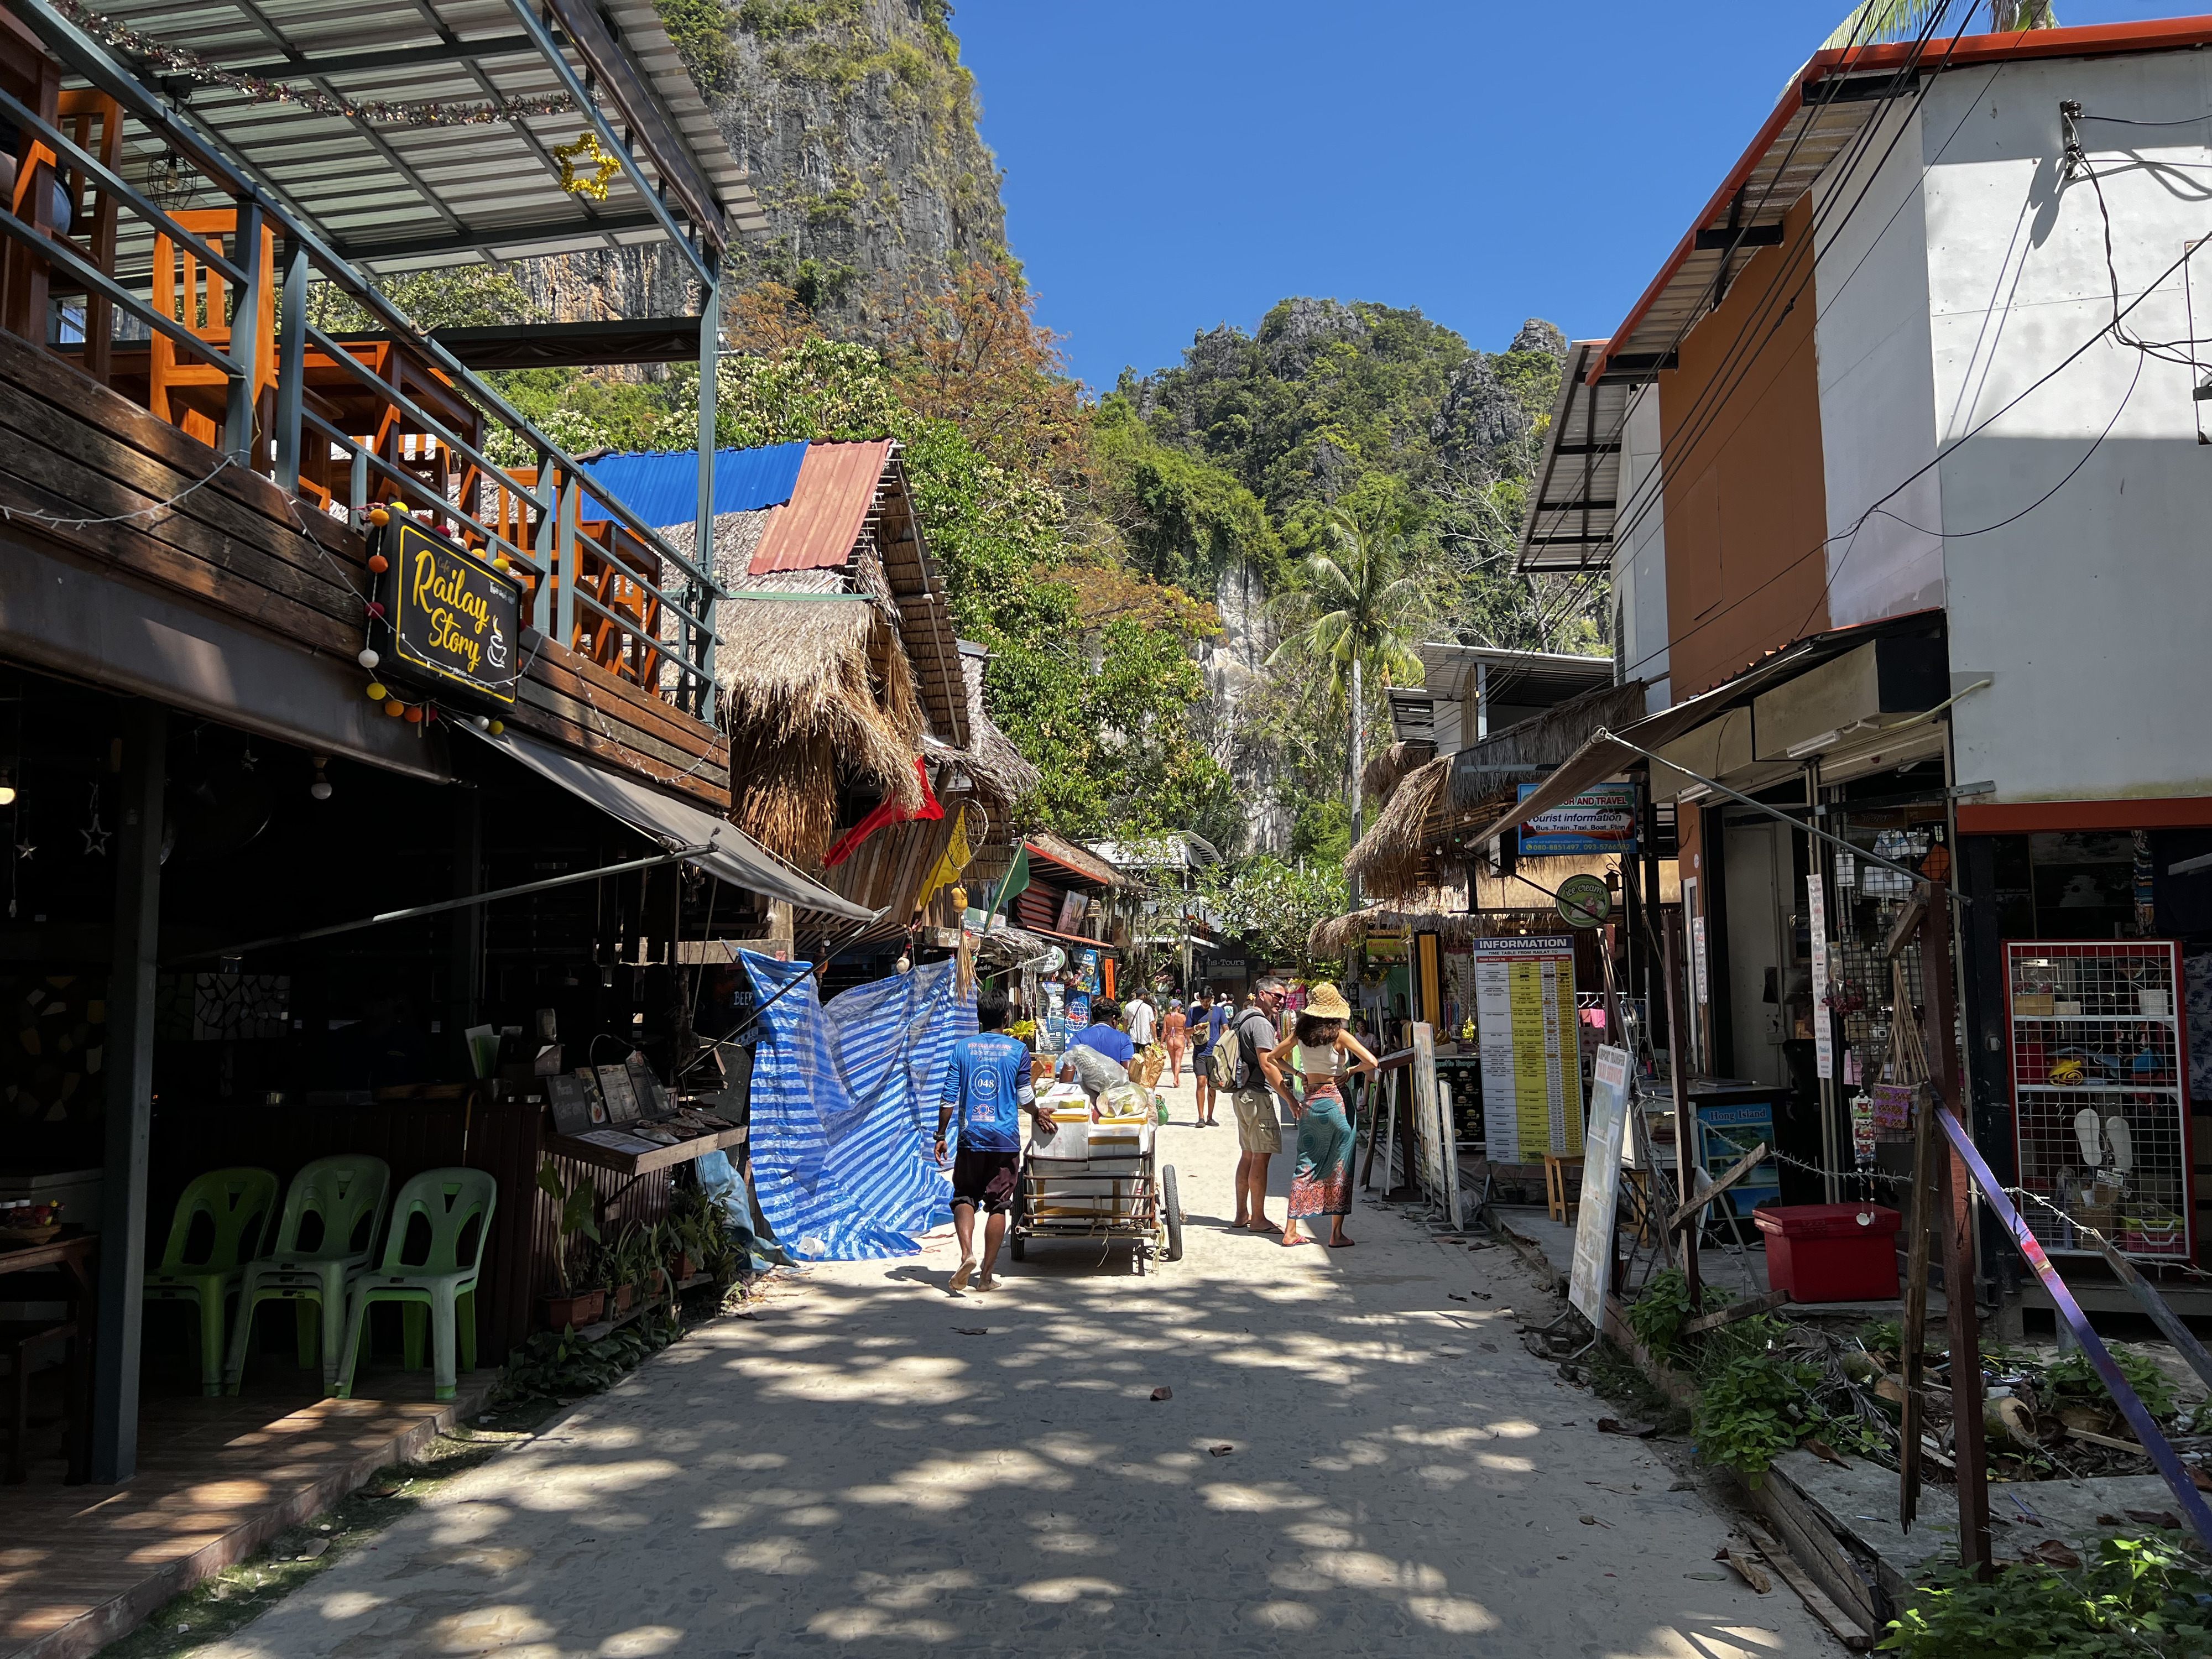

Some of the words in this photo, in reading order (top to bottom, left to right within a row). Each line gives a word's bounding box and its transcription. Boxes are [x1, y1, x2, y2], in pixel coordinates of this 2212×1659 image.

[413, 549, 490, 634] Railay
[428, 607, 481, 673] Story
[1576, 796, 1594, 805] AND
[1595, 796, 1627, 805] TRAVEL
[1564, 813, 1621, 822] information
[1564, 887, 1577, 897] ice
[1578, 884, 1603, 894] cream
[1479, 938, 1567, 949] INFORMATION
[1455, 1060, 1477, 1069] Burger
[978, 1078, 994, 1088] 048
[972, 1103, 995, 1115] SOS
[1709, 1110, 1736, 1123] Hong
[1737, 1108, 1767, 1119] Island
